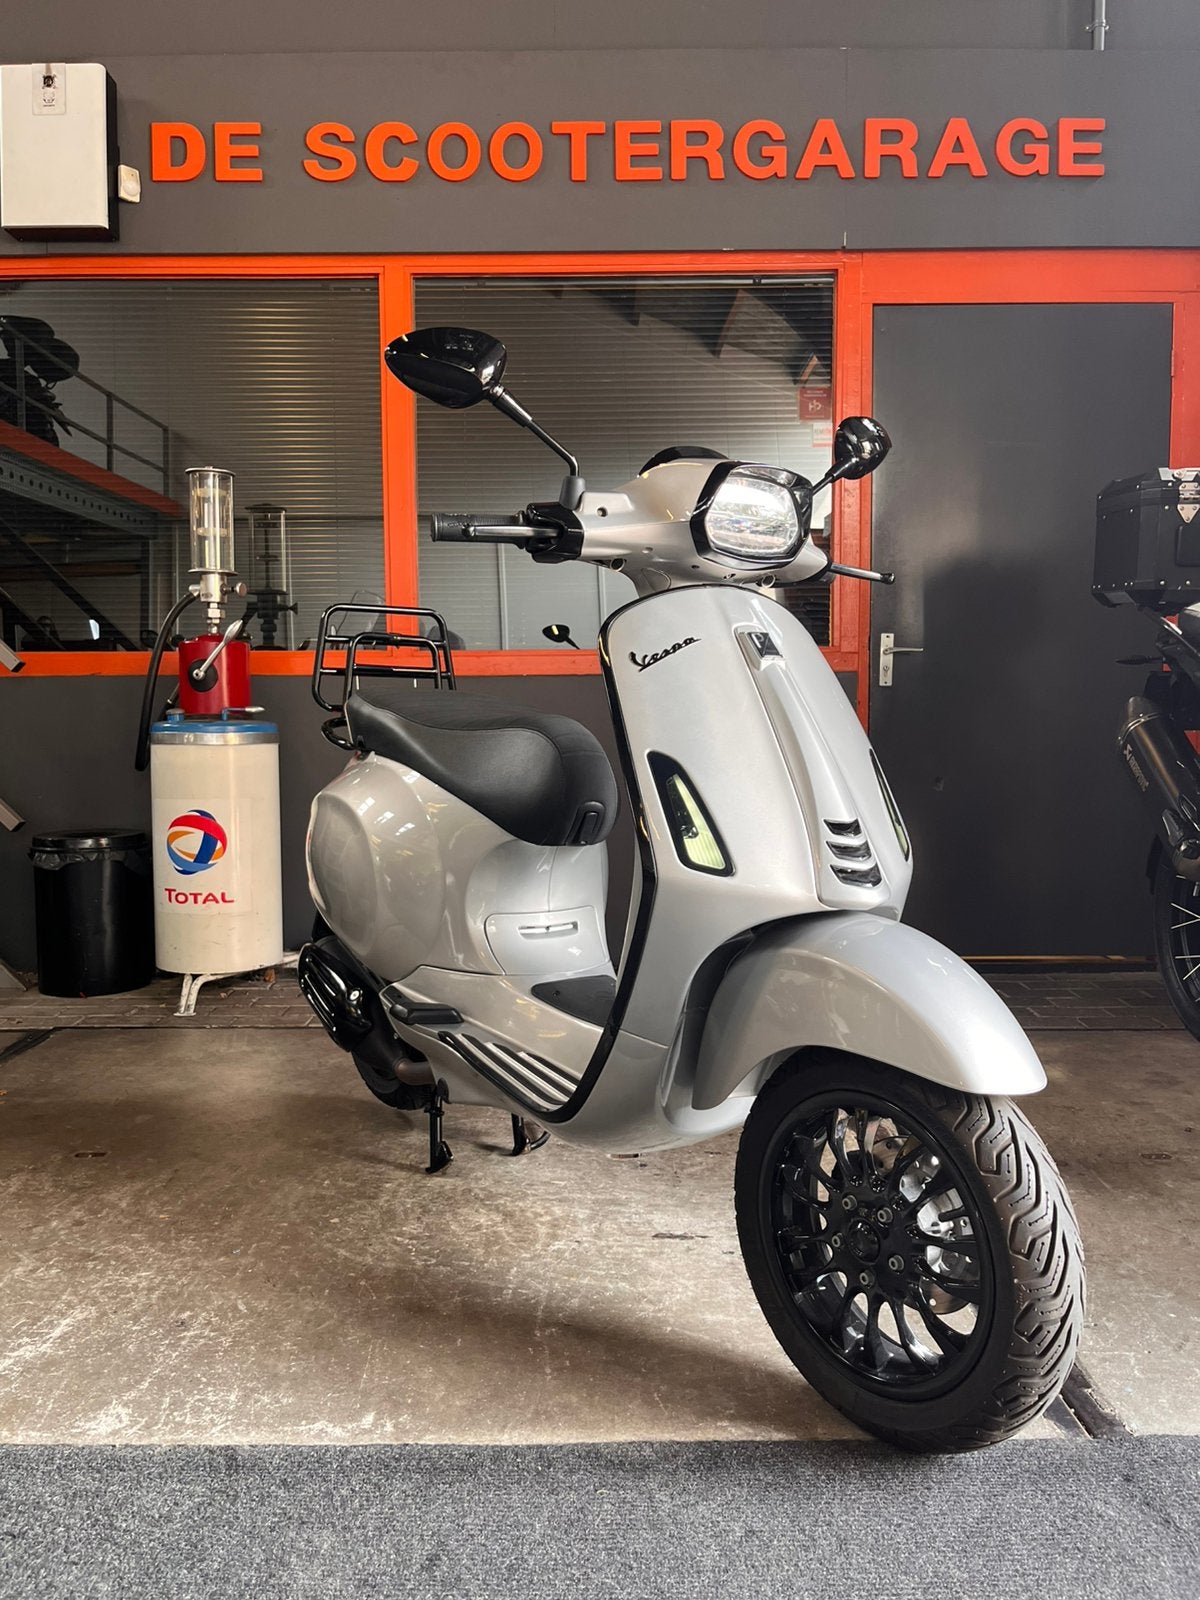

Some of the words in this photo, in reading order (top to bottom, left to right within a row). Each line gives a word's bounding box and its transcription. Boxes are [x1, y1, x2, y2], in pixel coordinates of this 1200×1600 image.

[150, 121, 264, 183] DE
[302, 118, 1105, 184] SCOOTERGARAGE
[629, 637, 702, 673] Vespa
[164, 888, 235, 905] TOTAL
